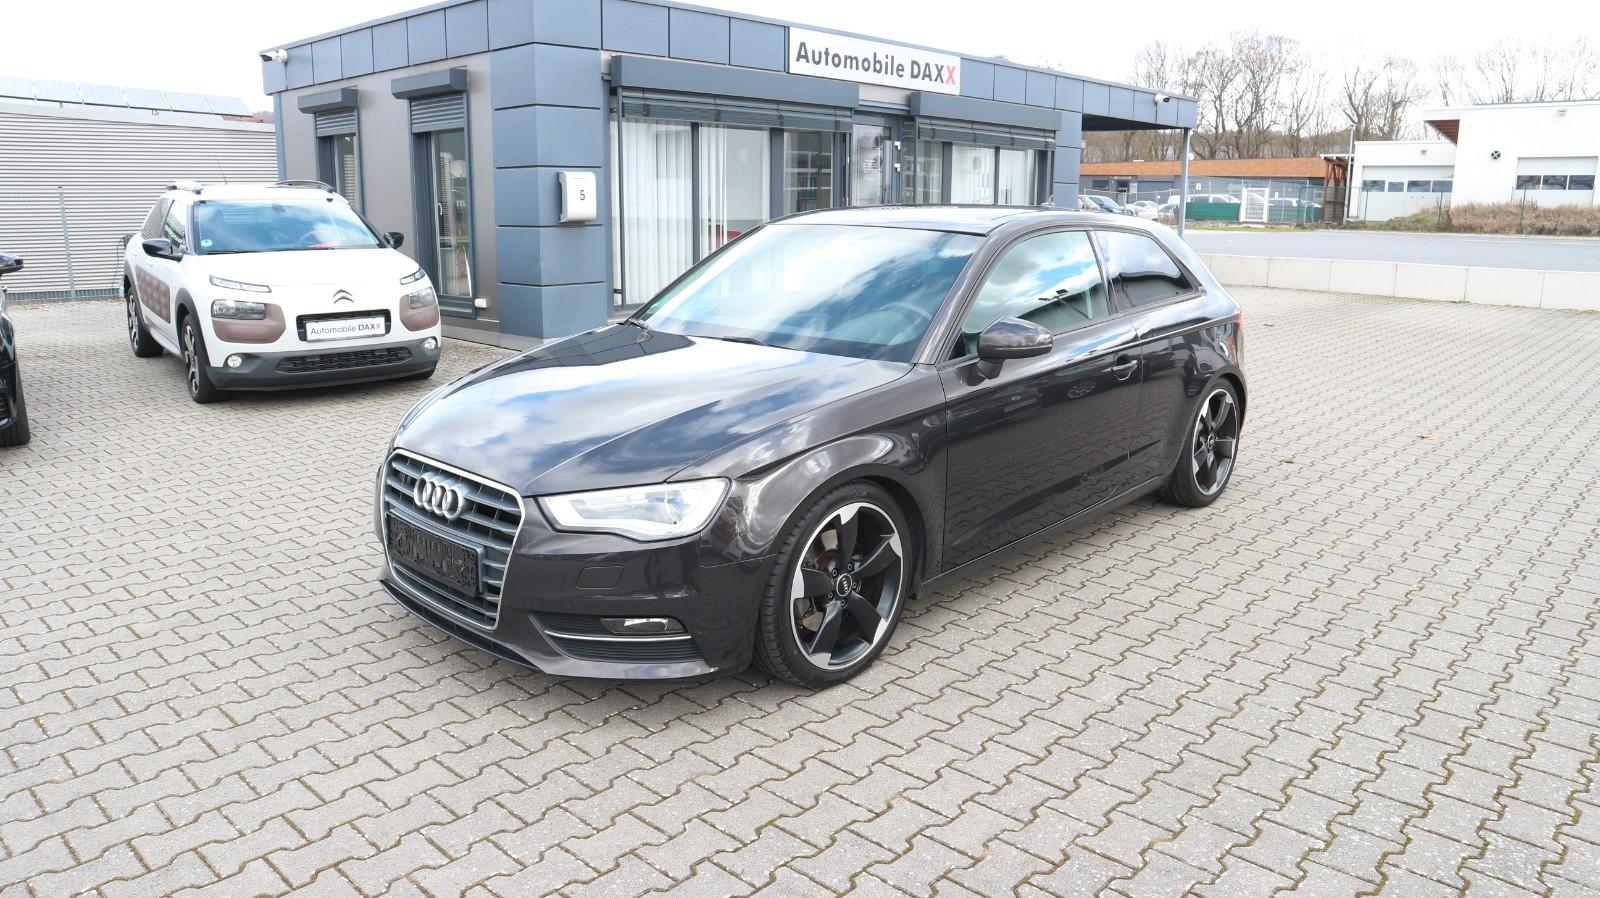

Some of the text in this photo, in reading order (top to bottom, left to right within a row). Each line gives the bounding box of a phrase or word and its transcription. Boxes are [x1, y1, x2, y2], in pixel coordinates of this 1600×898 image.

[796, 41, 955, 85] Automobile DAXX
[579, 189, 586, 201] 5
[310, 323, 381, 335] Automobile DAXX
